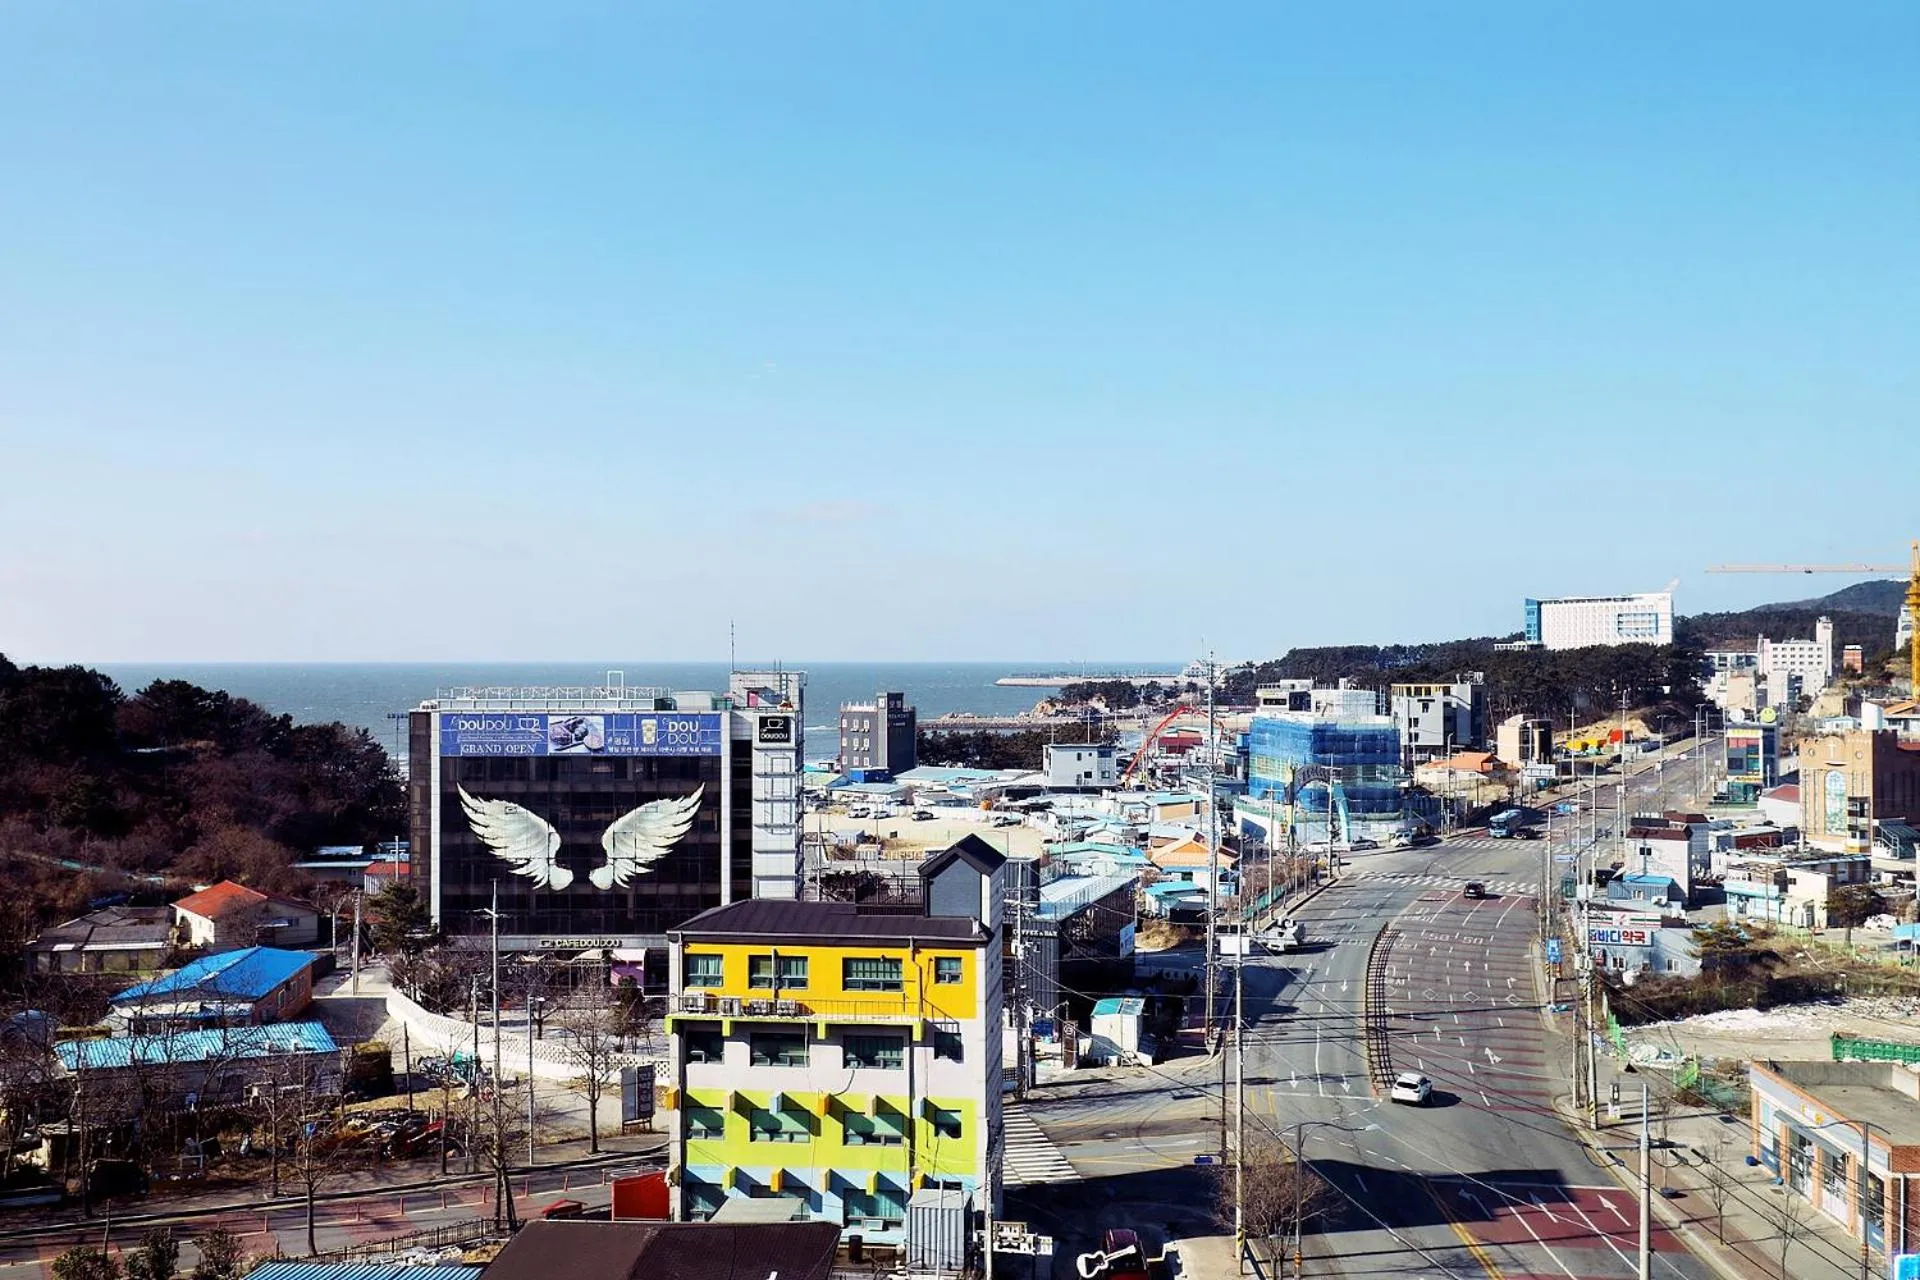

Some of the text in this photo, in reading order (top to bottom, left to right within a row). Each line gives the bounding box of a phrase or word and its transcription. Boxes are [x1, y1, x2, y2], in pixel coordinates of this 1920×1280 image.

[458, 720, 512, 731] DOUDOU
[668, 721, 699, 732] DOU
[667, 733, 699, 745] DOU
[461, 744, 537, 754] GRAND OPEN
